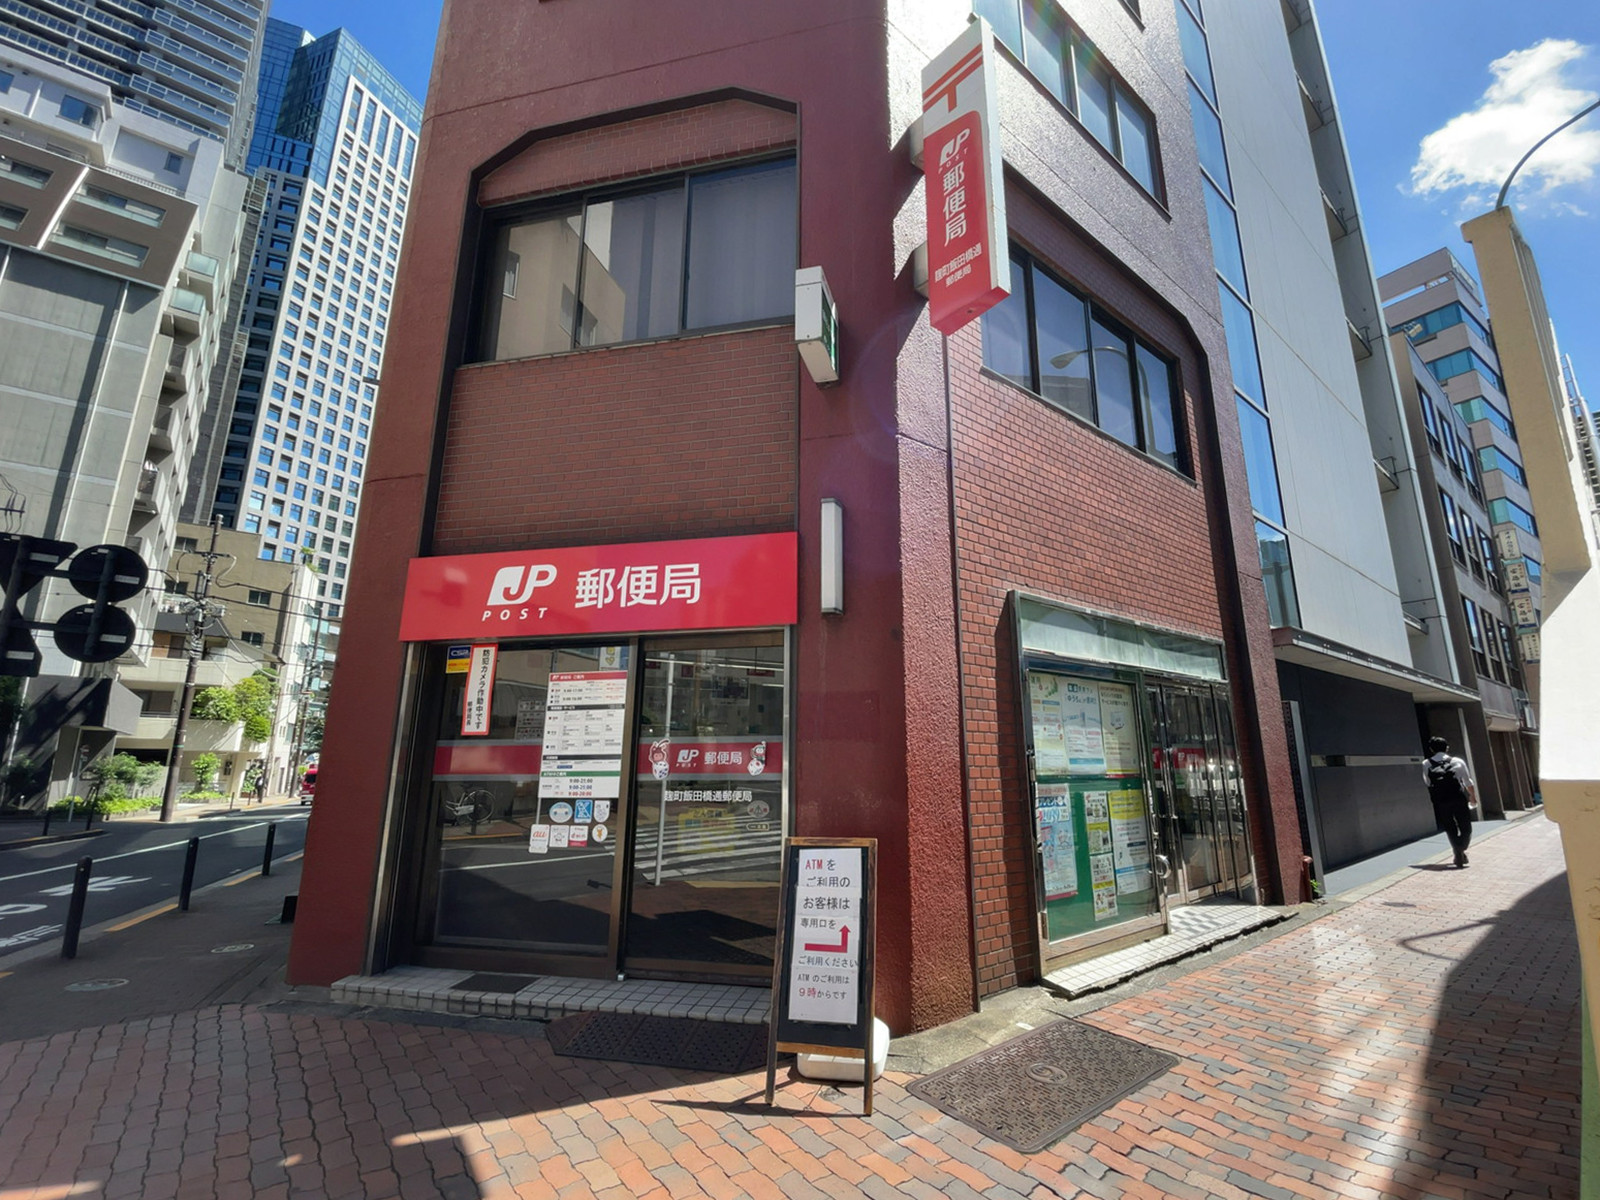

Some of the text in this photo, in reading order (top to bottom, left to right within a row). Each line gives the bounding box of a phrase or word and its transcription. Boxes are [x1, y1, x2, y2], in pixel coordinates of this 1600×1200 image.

[943, 161, 967, 247] 郵便局
[487, 563, 702, 609] JP 郵便局
[481, 607, 549, 622] POST
[475, 649, 491, 730] 防犯カメラ作動中です
[704, 751, 742, 765] 郵便局
[806, 876, 851, 888] ご利用の
[803, 896, 850, 910] お客様は
[800, 917, 837, 930] 専用口を
[798, 955, 860, 968] ご利用ください
[798, 986, 848, 1000] 9時からです
